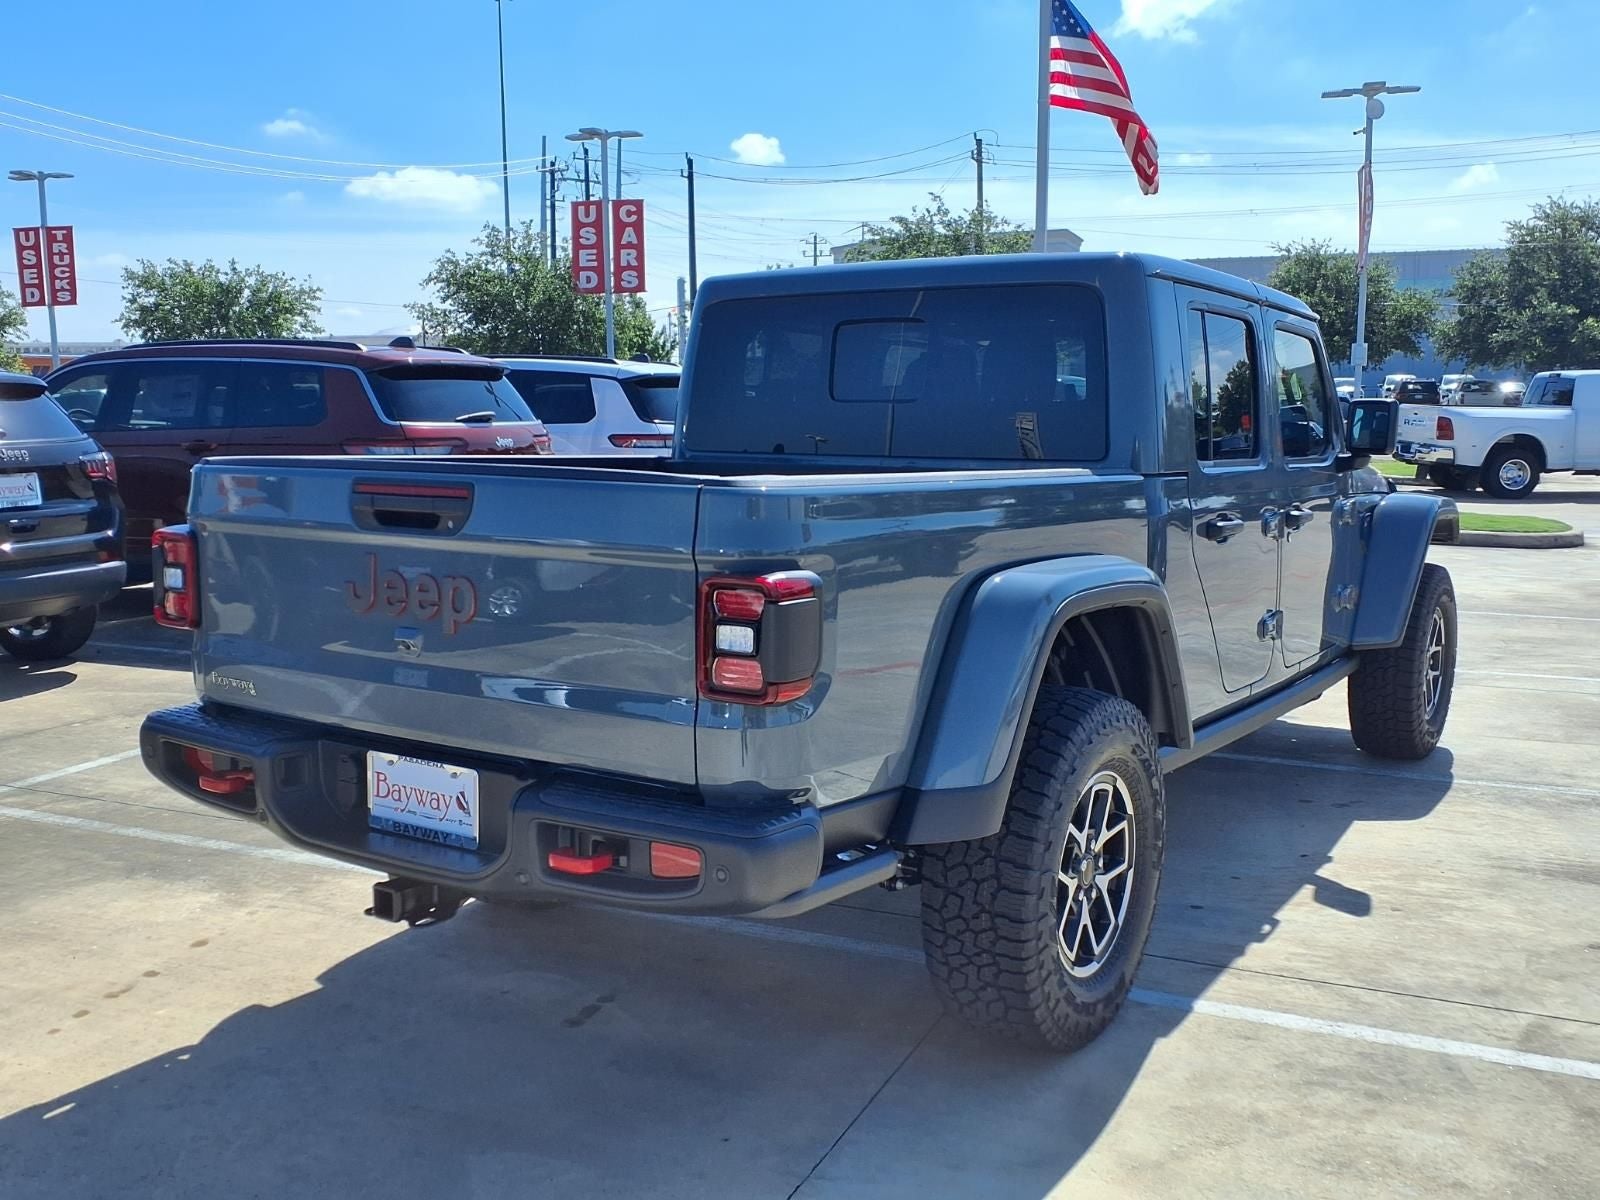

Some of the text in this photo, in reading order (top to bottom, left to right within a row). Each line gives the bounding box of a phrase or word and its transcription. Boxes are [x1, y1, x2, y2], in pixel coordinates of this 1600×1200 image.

[19, 230, 40, 303] USED
[51, 230, 71, 302] TRUCKS
[577, 205, 598, 289] USED
[619, 204, 639, 288] CARS
[0, 448, 29, 460] Jeep
[495, 436, 513, 448] Jeep
[345, 552, 477, 634] Jeep
[398, 755, 446, 769] PASADENA
[375, 771, 452, 821] Bayway
[393, 822, 449, 842] BAYWAY
